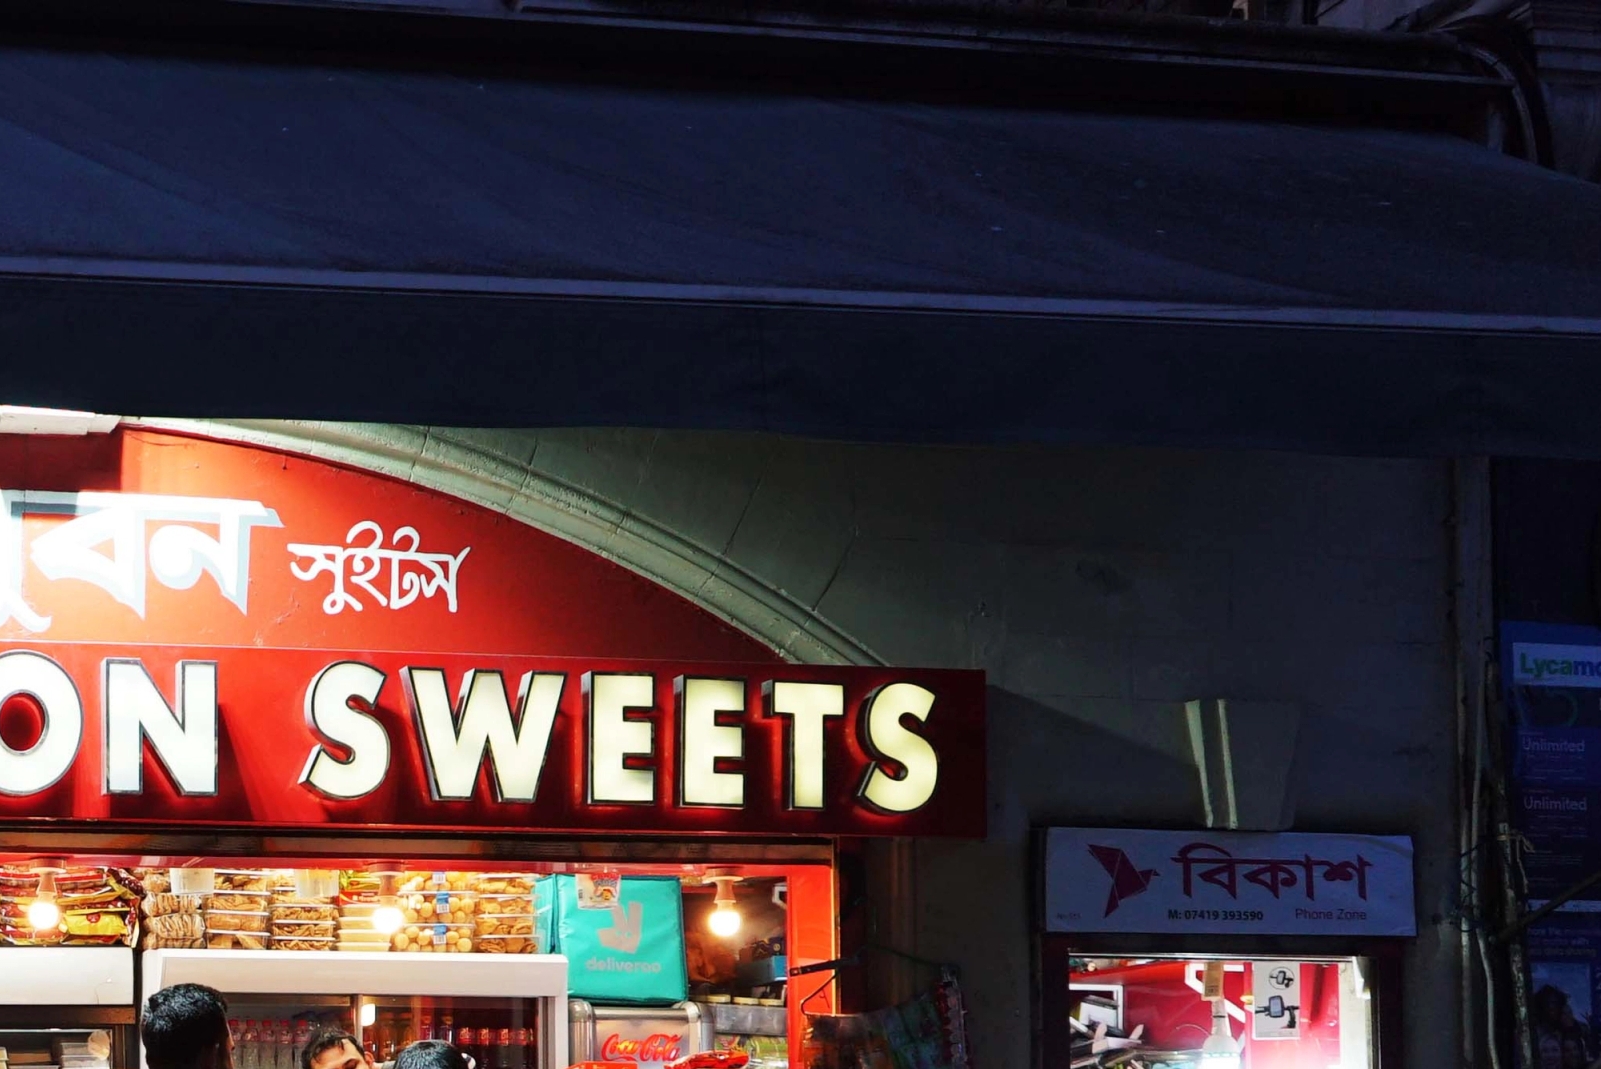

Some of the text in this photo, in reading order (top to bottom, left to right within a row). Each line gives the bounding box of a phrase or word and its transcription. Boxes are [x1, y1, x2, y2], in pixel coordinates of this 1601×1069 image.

[287, 519, 472, 615] সুইটস
[297, 660, 938, 814] SWEETS
[1523, 738, 1586, 752] Unlimited
[1524, 796, 1588, 811] Unlimited
[1170, 843, 1374, 901] বিকাশ
[1168, 910, 1264, 921] M: 07419 393590
[1295, 908, 1367, 920] Phone Zone
[585, 957, 661, 973] deliveroo
